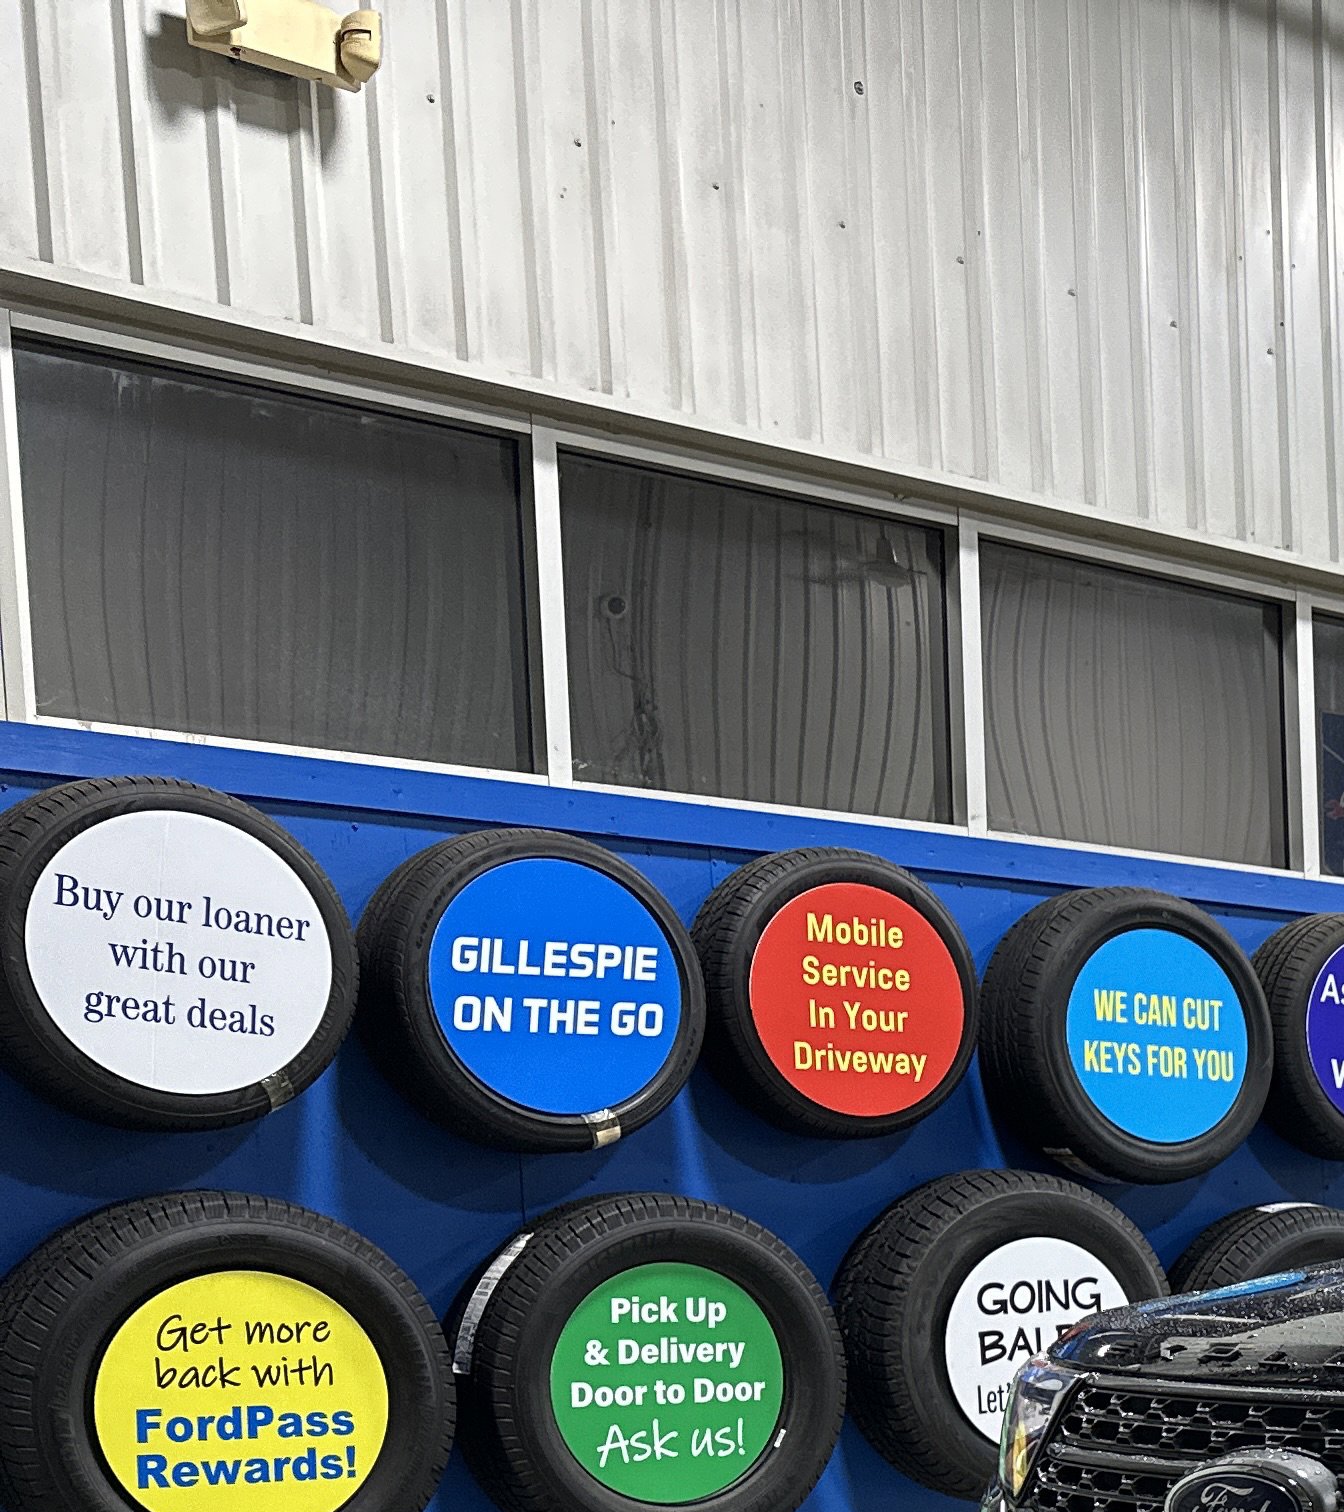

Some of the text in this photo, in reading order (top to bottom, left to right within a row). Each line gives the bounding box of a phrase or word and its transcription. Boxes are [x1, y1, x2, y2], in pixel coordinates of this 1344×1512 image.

[53, 873, 310, 942] Buy our loaner
[805, 912, 904, 950] Mobile
[108, 938, 256, 985] with our
[451, 935, 659, 982] GILLESPIE
[801, 955, 911, 992] Service
[83, 988, 276, 1039] great deals
[453, 995, 664, 1039] ON THE GO
[808, 999, 909, 1034] In Your
[1093, 987, 1223, 1032] WE CAN CUT
[793, 1040, 928, 1083] Driveway
[1082, 1040, 1234, 1083] KEYS FOR YOU
[610, 1296, 727, 1329] Pick Up
[977, 1277, 1101, 1315] GOING
[156, 1314, 331, 1352] Get more
[584, 1337, 746, 1369] & Delivery
[155, 1354, 334, 1389] back with
[570, 1377, 766, 1408] Door to Door
[977, 1382, 1011, 1414] Let'
[135, 1404, 356, 1444] FordPass
[596, 1417, 746, 1468] Ask us!
[136, 1445, 358, 1490] Rewards!
